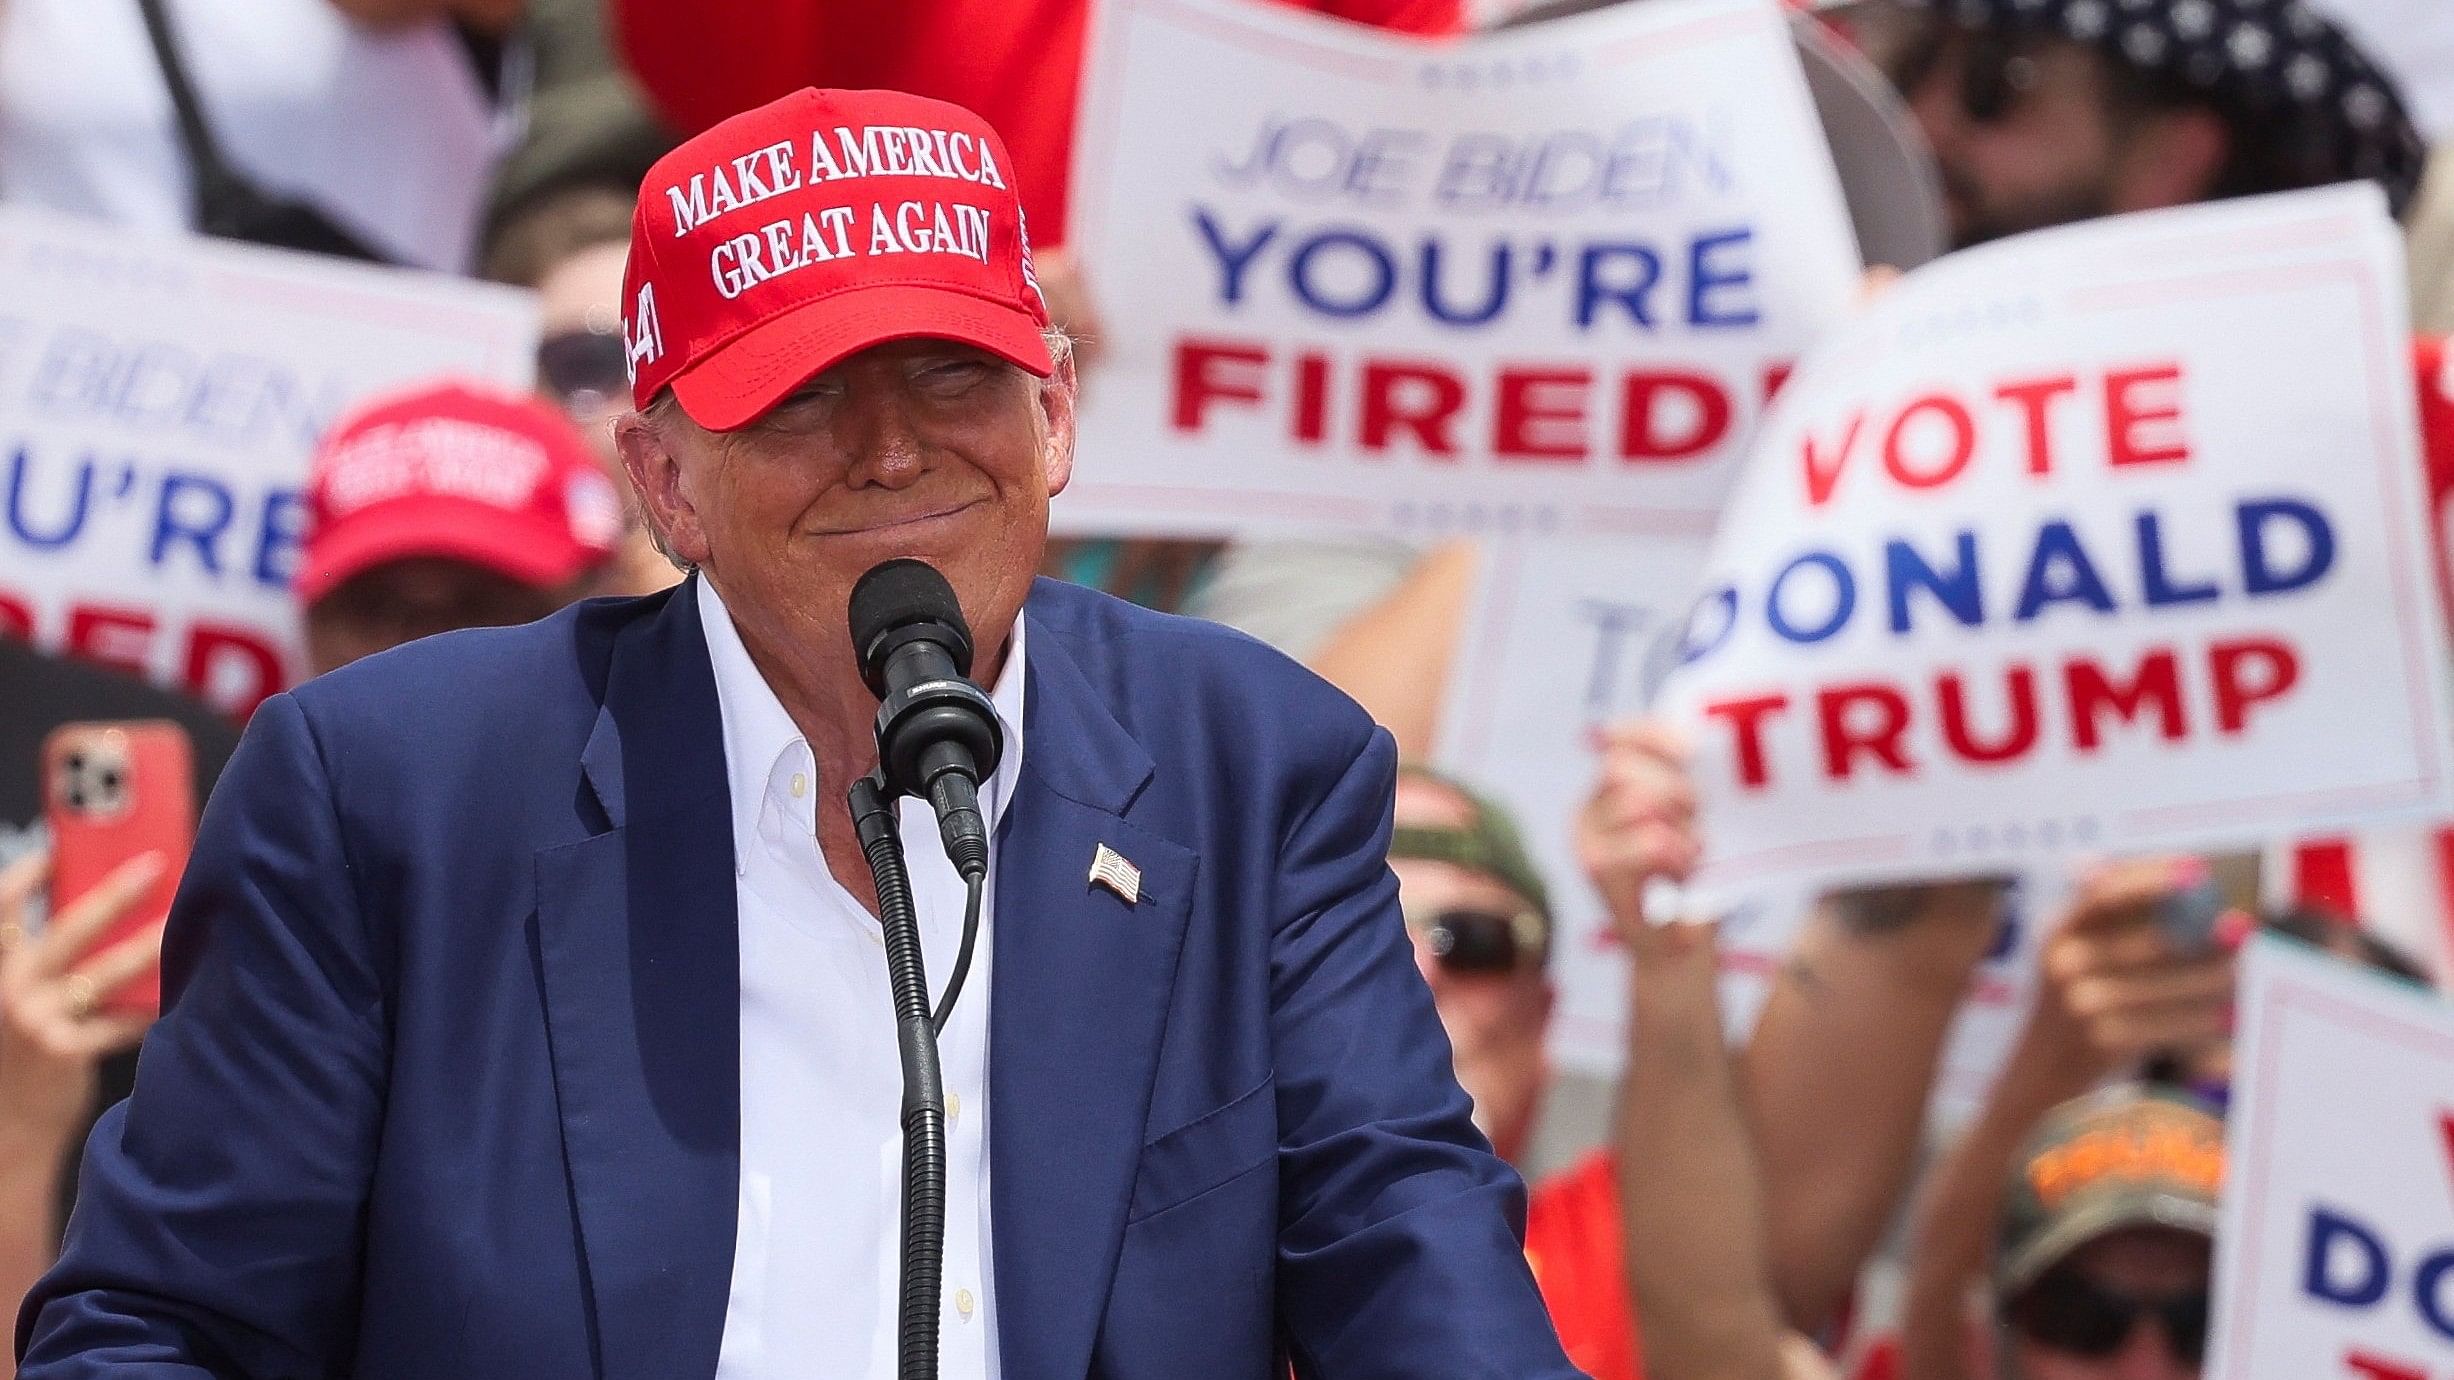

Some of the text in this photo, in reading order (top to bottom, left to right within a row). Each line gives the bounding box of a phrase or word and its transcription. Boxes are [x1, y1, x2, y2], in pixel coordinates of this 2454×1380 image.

[666, 126, 1006, 238] MAKE AMERICA
[1206, 112, 1735, 212] JOE BIDEN
[711, 206, 856, 299] GREAT
[869, 202, 991, 265] AGAIN
[1188, 203, 1762, 330] YOU'RE
[1803, 360, 2190, 507] VOTE
[1682, 494, 2337, 664] DONALD
[1706, 635, 2303, 790] TRUMP
